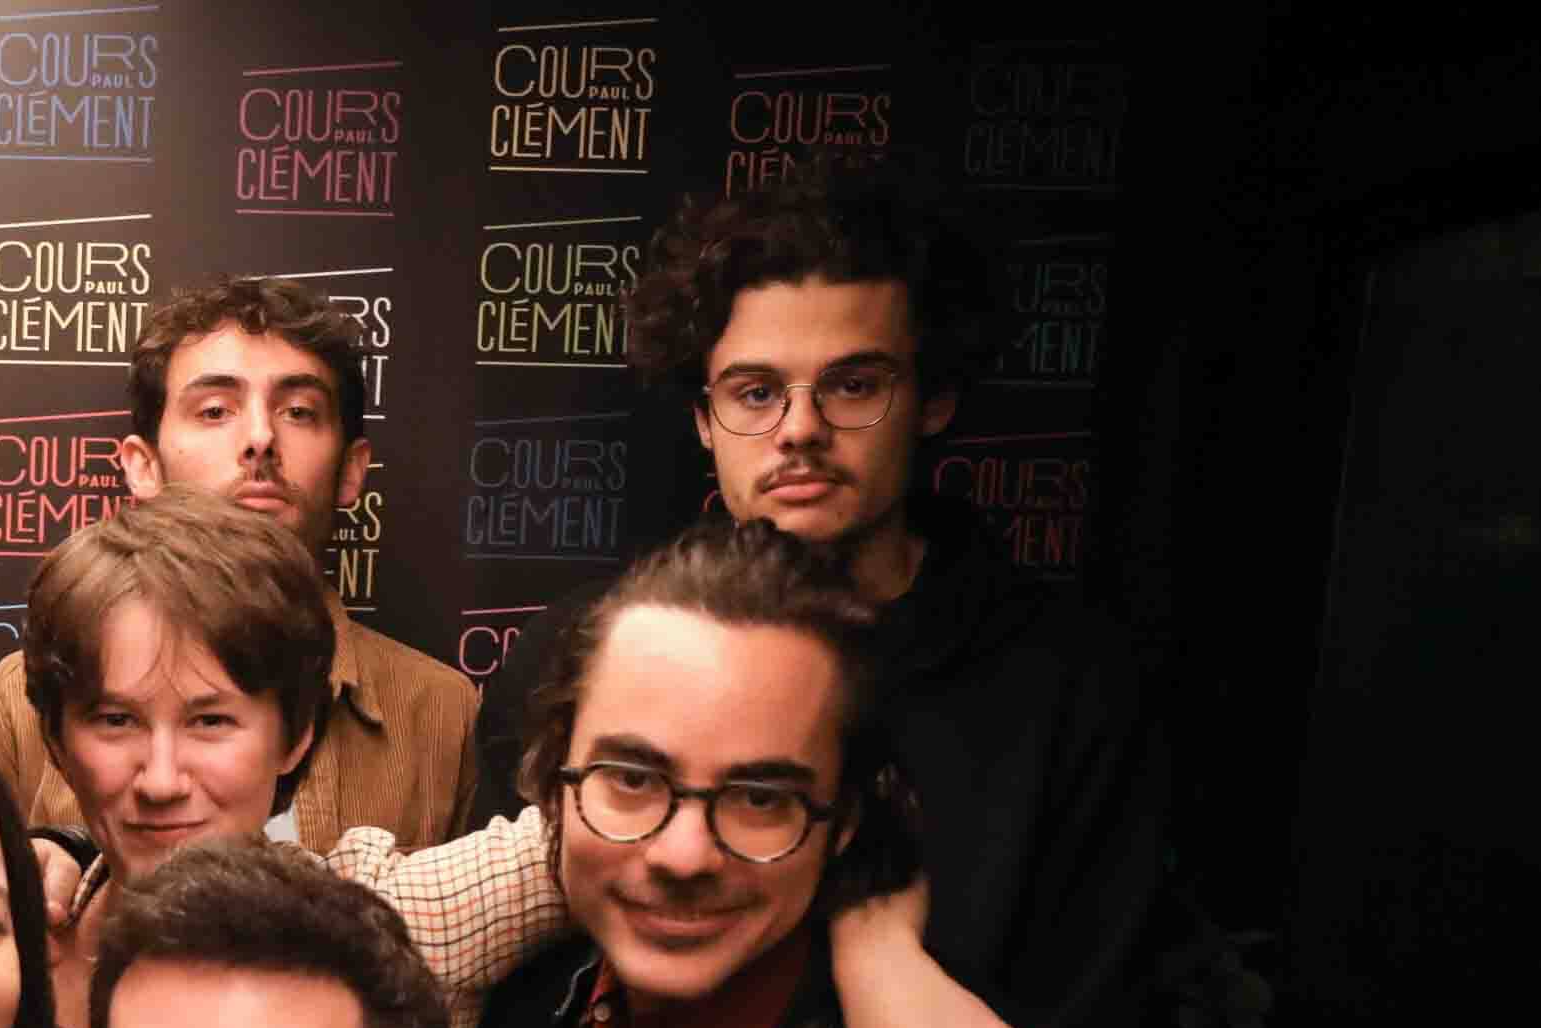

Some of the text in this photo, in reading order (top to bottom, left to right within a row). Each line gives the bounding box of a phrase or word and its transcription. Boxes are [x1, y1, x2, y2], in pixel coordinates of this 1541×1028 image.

[91, 75, 133, 89] PAUL
[493, 44, 658, 99] COURS
[589, 86, 631, 99] PAUL
[238, 88, 402, 144] COURS
[334, 129, 376, 144] PAUL
[490, 101, 651, 161] CLÉMENT
[731, 89, 892, 144] COURS
[236, 144, 398, 202] CLÉMENT
[84, 280, 128, 295] PAUL
[573, 281, 616, 297] PAUL
[77, 473, 121, 489] PAUL
[470, 438, 627, 491] COURS
[467, 493, 627, 549] CLÉMENT
